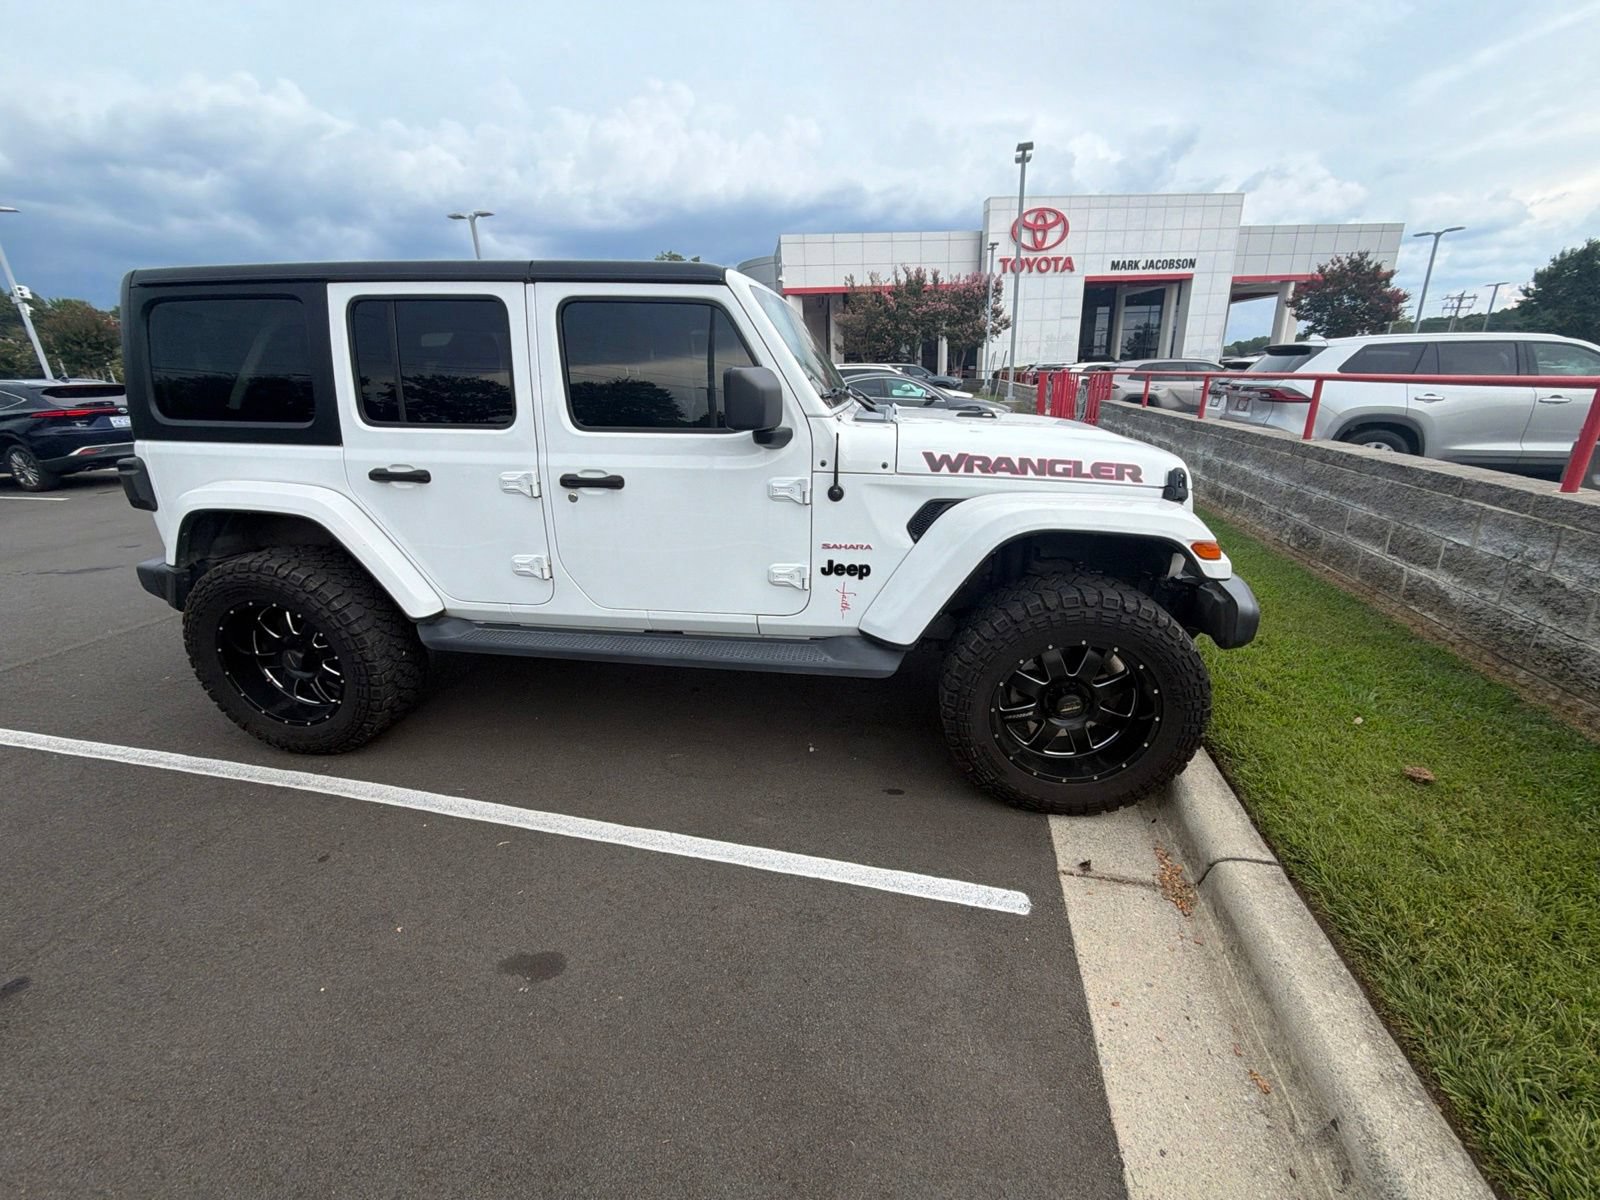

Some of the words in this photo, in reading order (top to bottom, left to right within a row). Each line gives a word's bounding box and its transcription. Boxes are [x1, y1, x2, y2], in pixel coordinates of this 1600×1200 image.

[999, 256, 1075, 273] TOYOTA
[1110, 260, 1140, 271] MARK
[1141, 258, 1196, 270] JACOBSON
[922, 451, 1143, 483] WRANGLER
[820, 559, 871, 580] Jeep
